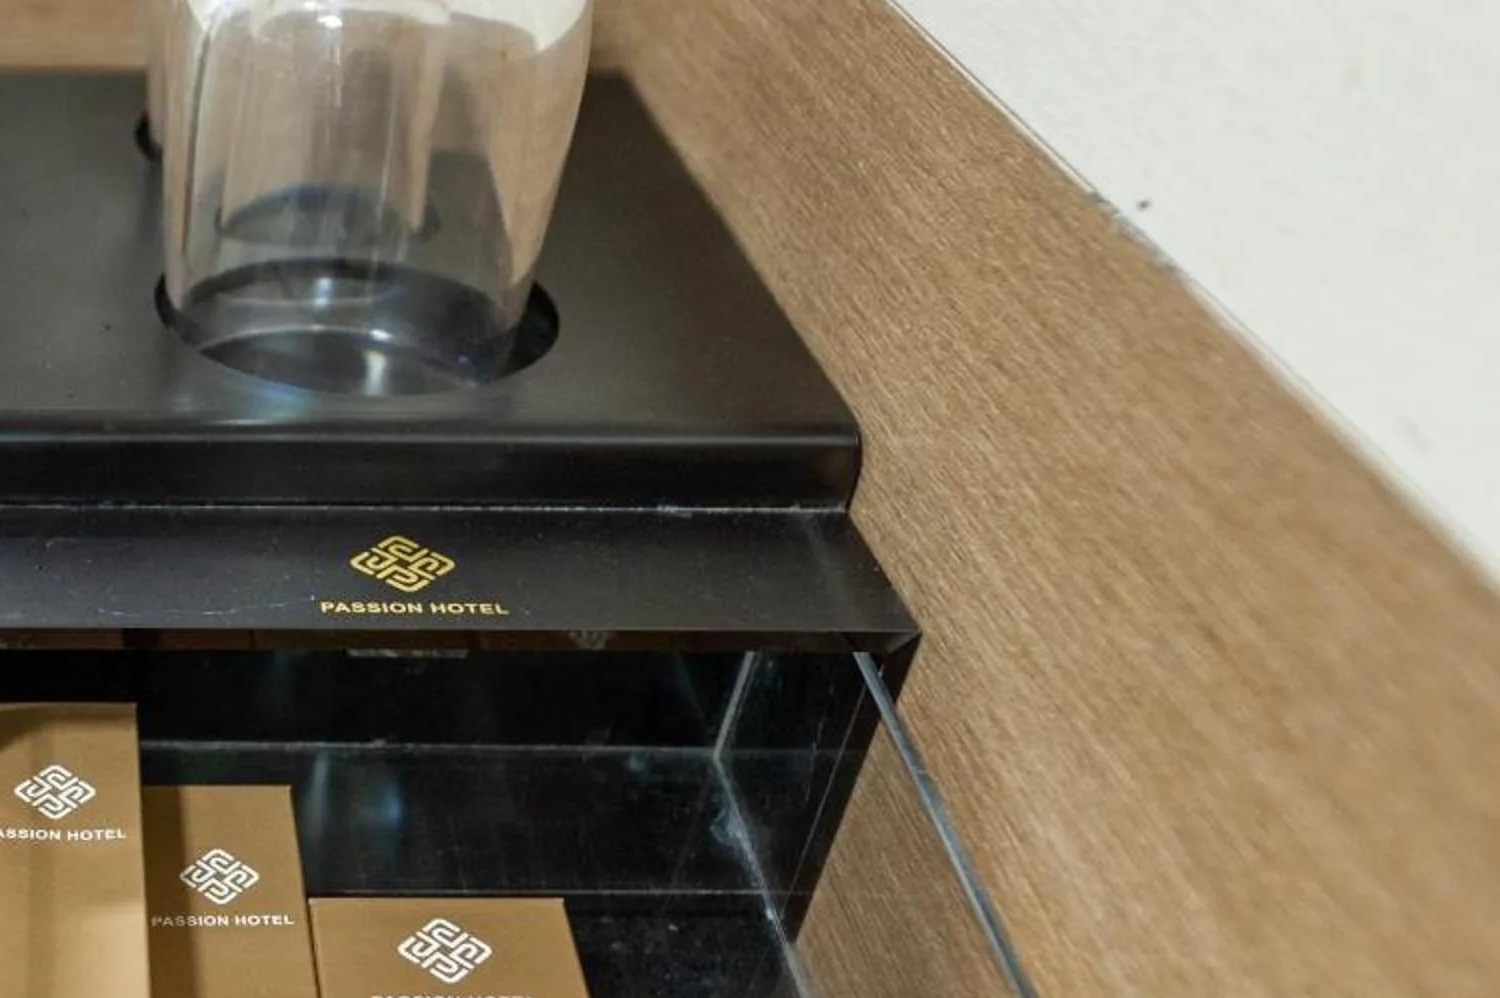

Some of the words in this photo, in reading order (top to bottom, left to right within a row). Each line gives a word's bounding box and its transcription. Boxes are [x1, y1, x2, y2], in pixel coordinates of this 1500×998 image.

[320, 601, 423, 615] PASSION
[430, 602, 510, 616] HOTEL
[67, 827, 127, 841] HOTEL
[151, 914, 230, 927] PASSION
[235, 914, 295, 926] HOTEL
